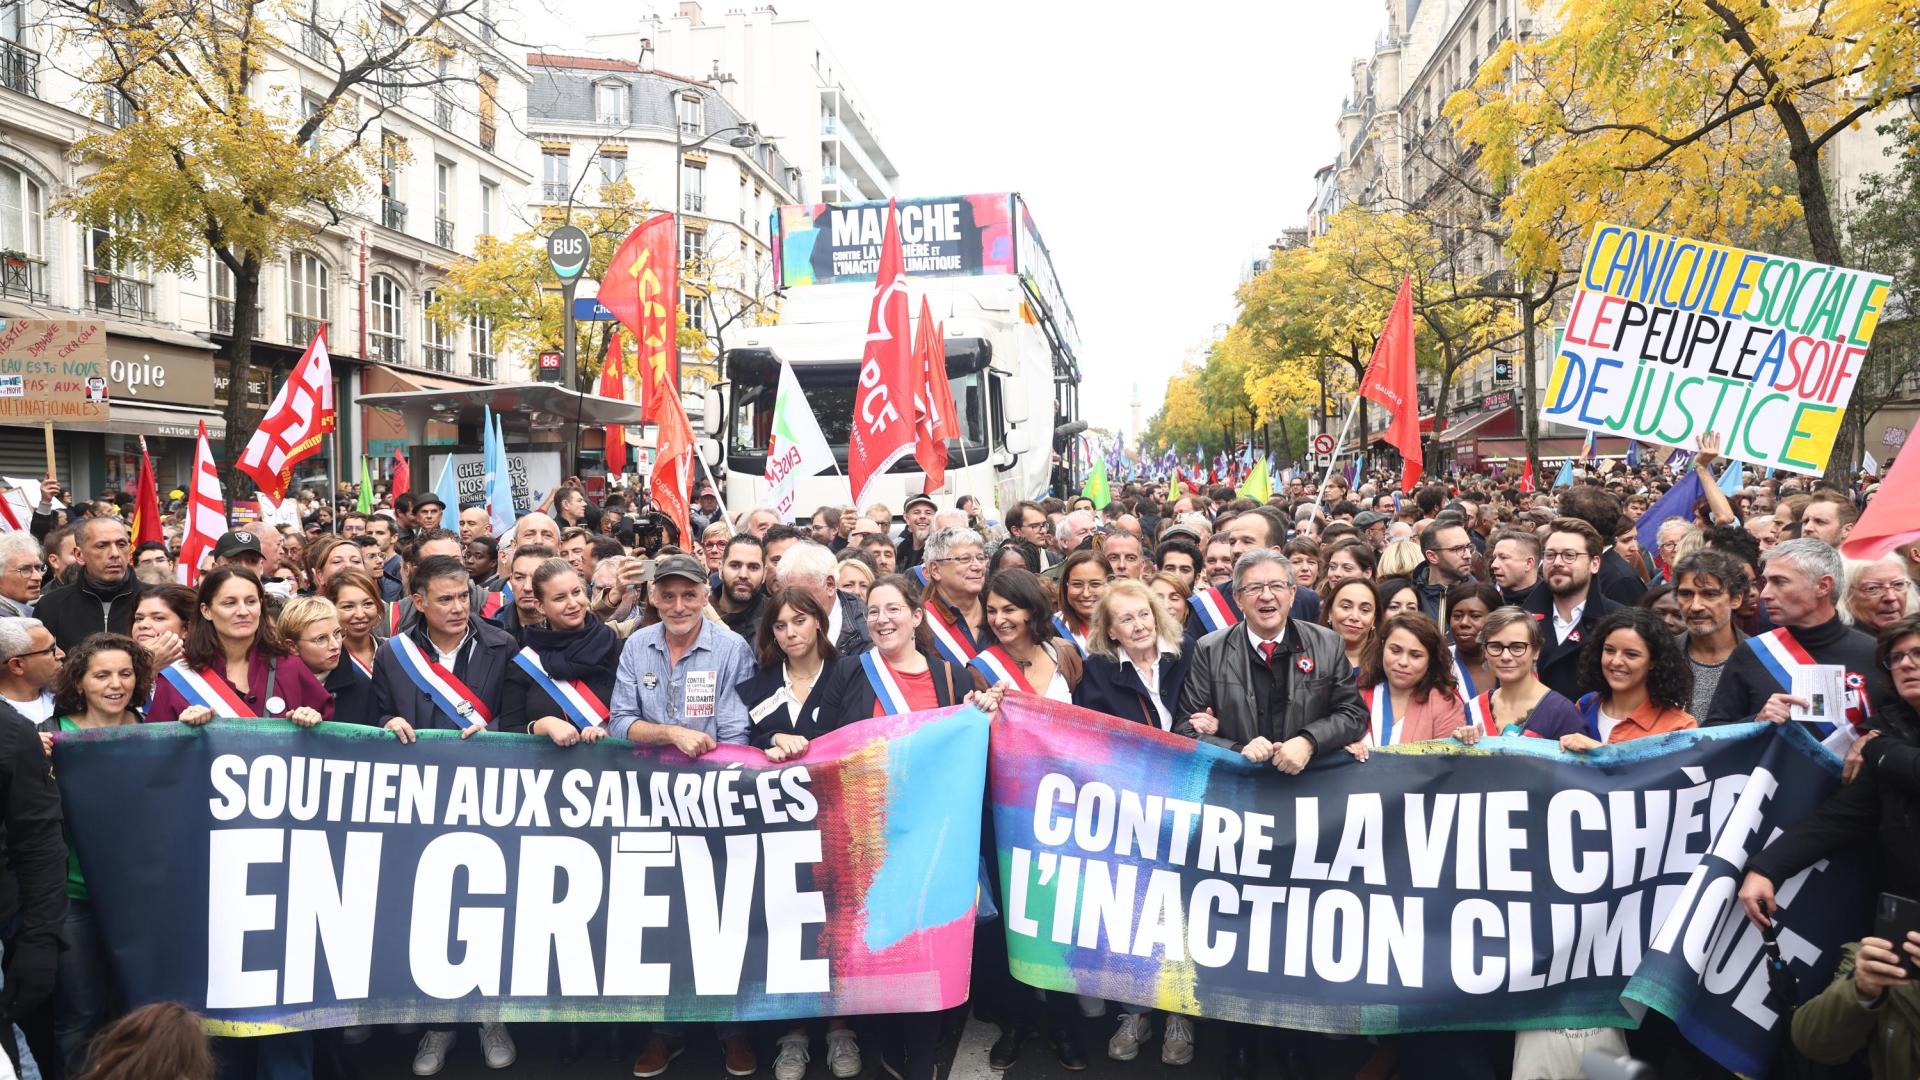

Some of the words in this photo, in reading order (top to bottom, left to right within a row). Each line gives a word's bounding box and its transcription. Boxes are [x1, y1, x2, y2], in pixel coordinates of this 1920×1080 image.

[553, 239, 582, 254] BUS
[931, 246, 940, 256] ET
[905, 256, 961, 271] LIMATIQUE
[1565, 291, 1626, 349] LE
[1612, 301, 1773, 380] PEUPLE
[1752, 329, 1787, 387] A
[542, 355, 557, 366] 86
[110, 354, 165, 395] opie
[24, 380, 44, 392] PAS
[54, 381, 81, 392] AUX
[1546, 351, 1624, 425] DE
[859, 358, 899, 435] PCF
[0, 399, 100, 417] ULTINATIONALES
[158, 426, 190, 436] NATION
[459, 478, 483, 494] NOS
[461, 493, 486, 503] DONNEN
[209, 754, 439, 821] SOUTIEN
[443, 766, 554, 827] AUX
[1033, 773, 1275, 878] CONTRE
[1290, 792, 1387, 886] LA
[1404, 790, 1532, 892] VIE
[206, 828, 383, 1009] EN
[1008, 847, 1424, 988] L'INACTION
